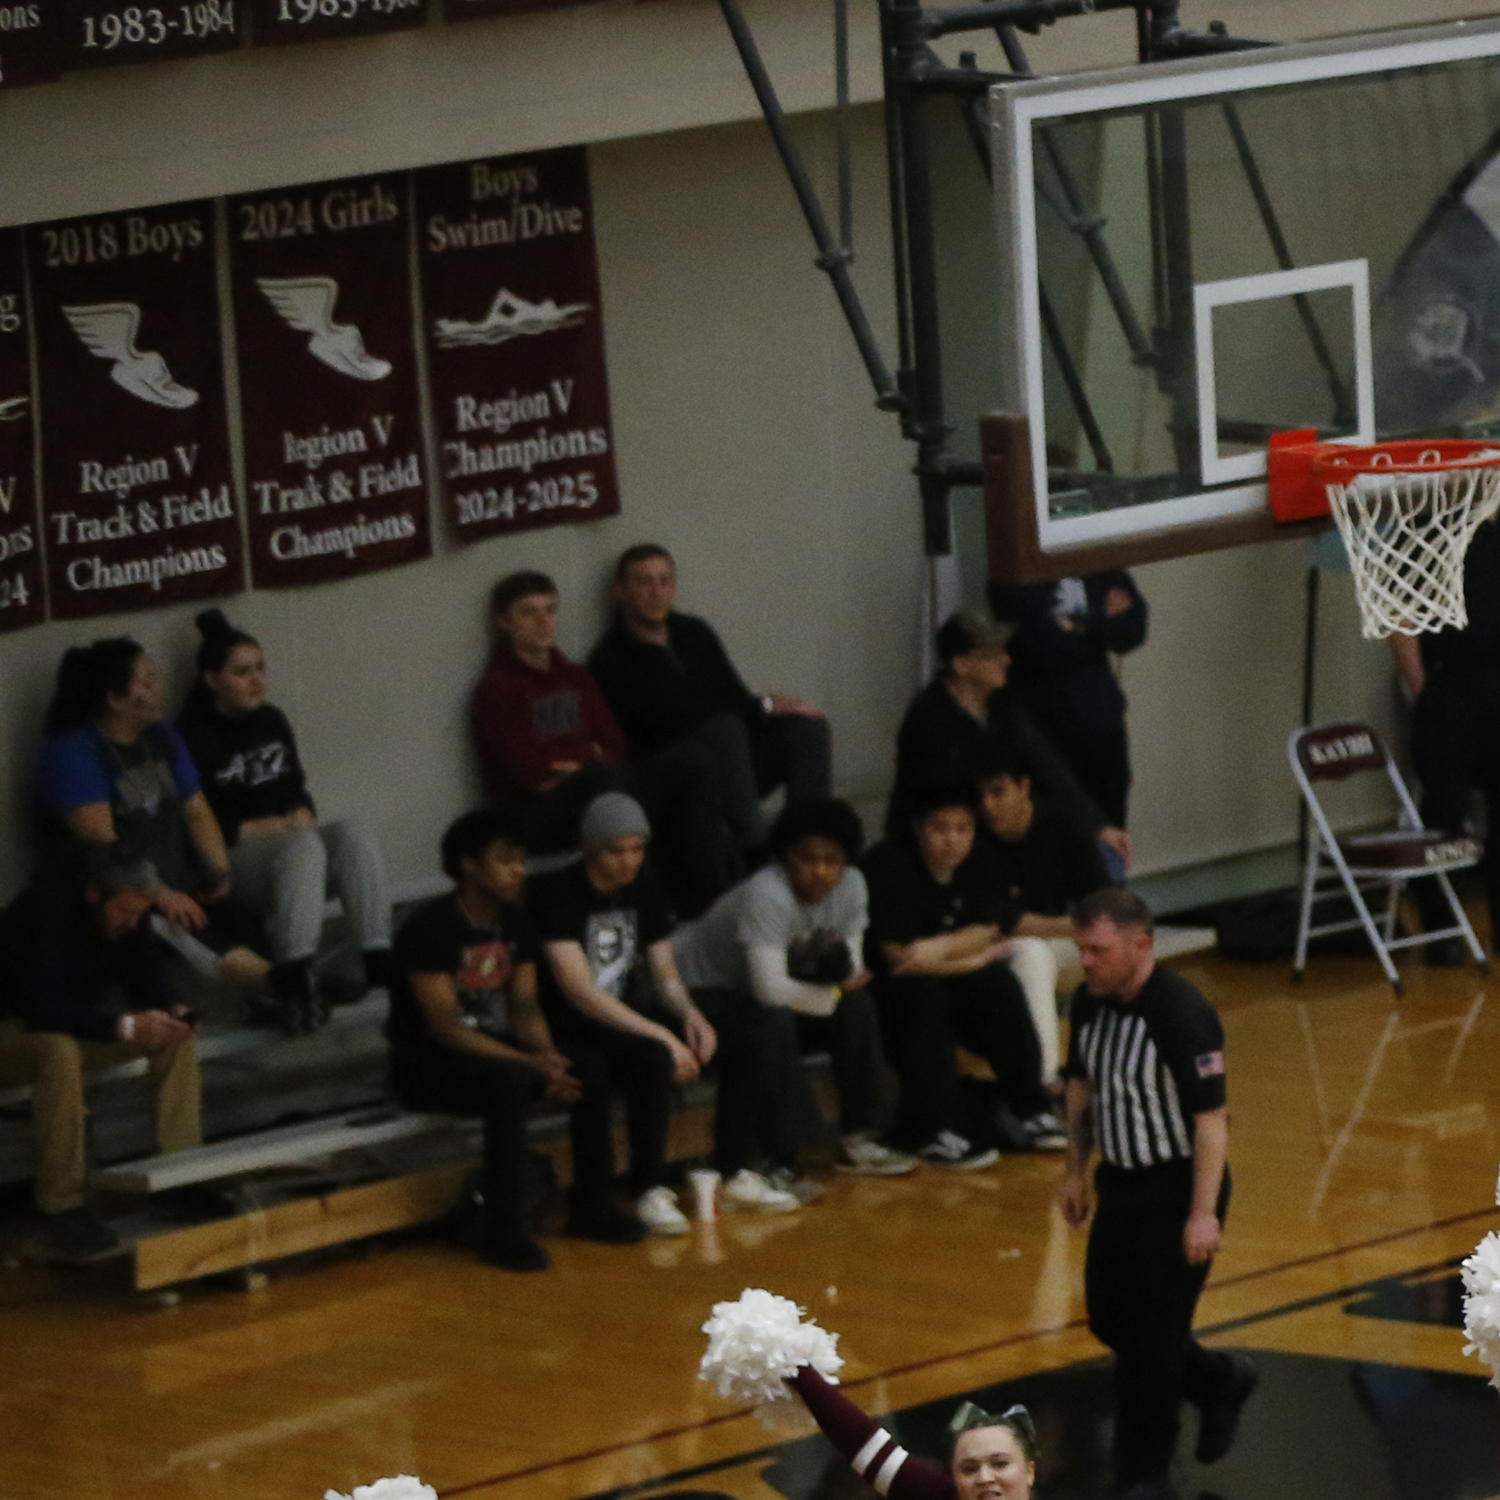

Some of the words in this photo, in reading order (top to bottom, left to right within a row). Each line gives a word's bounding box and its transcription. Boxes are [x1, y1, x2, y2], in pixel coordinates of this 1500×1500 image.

[470, 164, 540, 203] Boys
[240, 200, 315, 240] 2024
[321, 183, 399, 232] Girls
[426, 201, 584, 253] Swim/Dive
[42, 222, 119, 267] 2018
[126, 216, 204, 263] Boys
[371, 413, 394, 448] V
[455, 389, 551, 434] Region
[551, 379, 576, 416] V
[79, 454, 171, 500] Region
[174, 443, 200, 478] V
[51, 505, 137, 544] Track
[161, 484, 235, 529] Field
[66, 544, 228, 591] Champions
